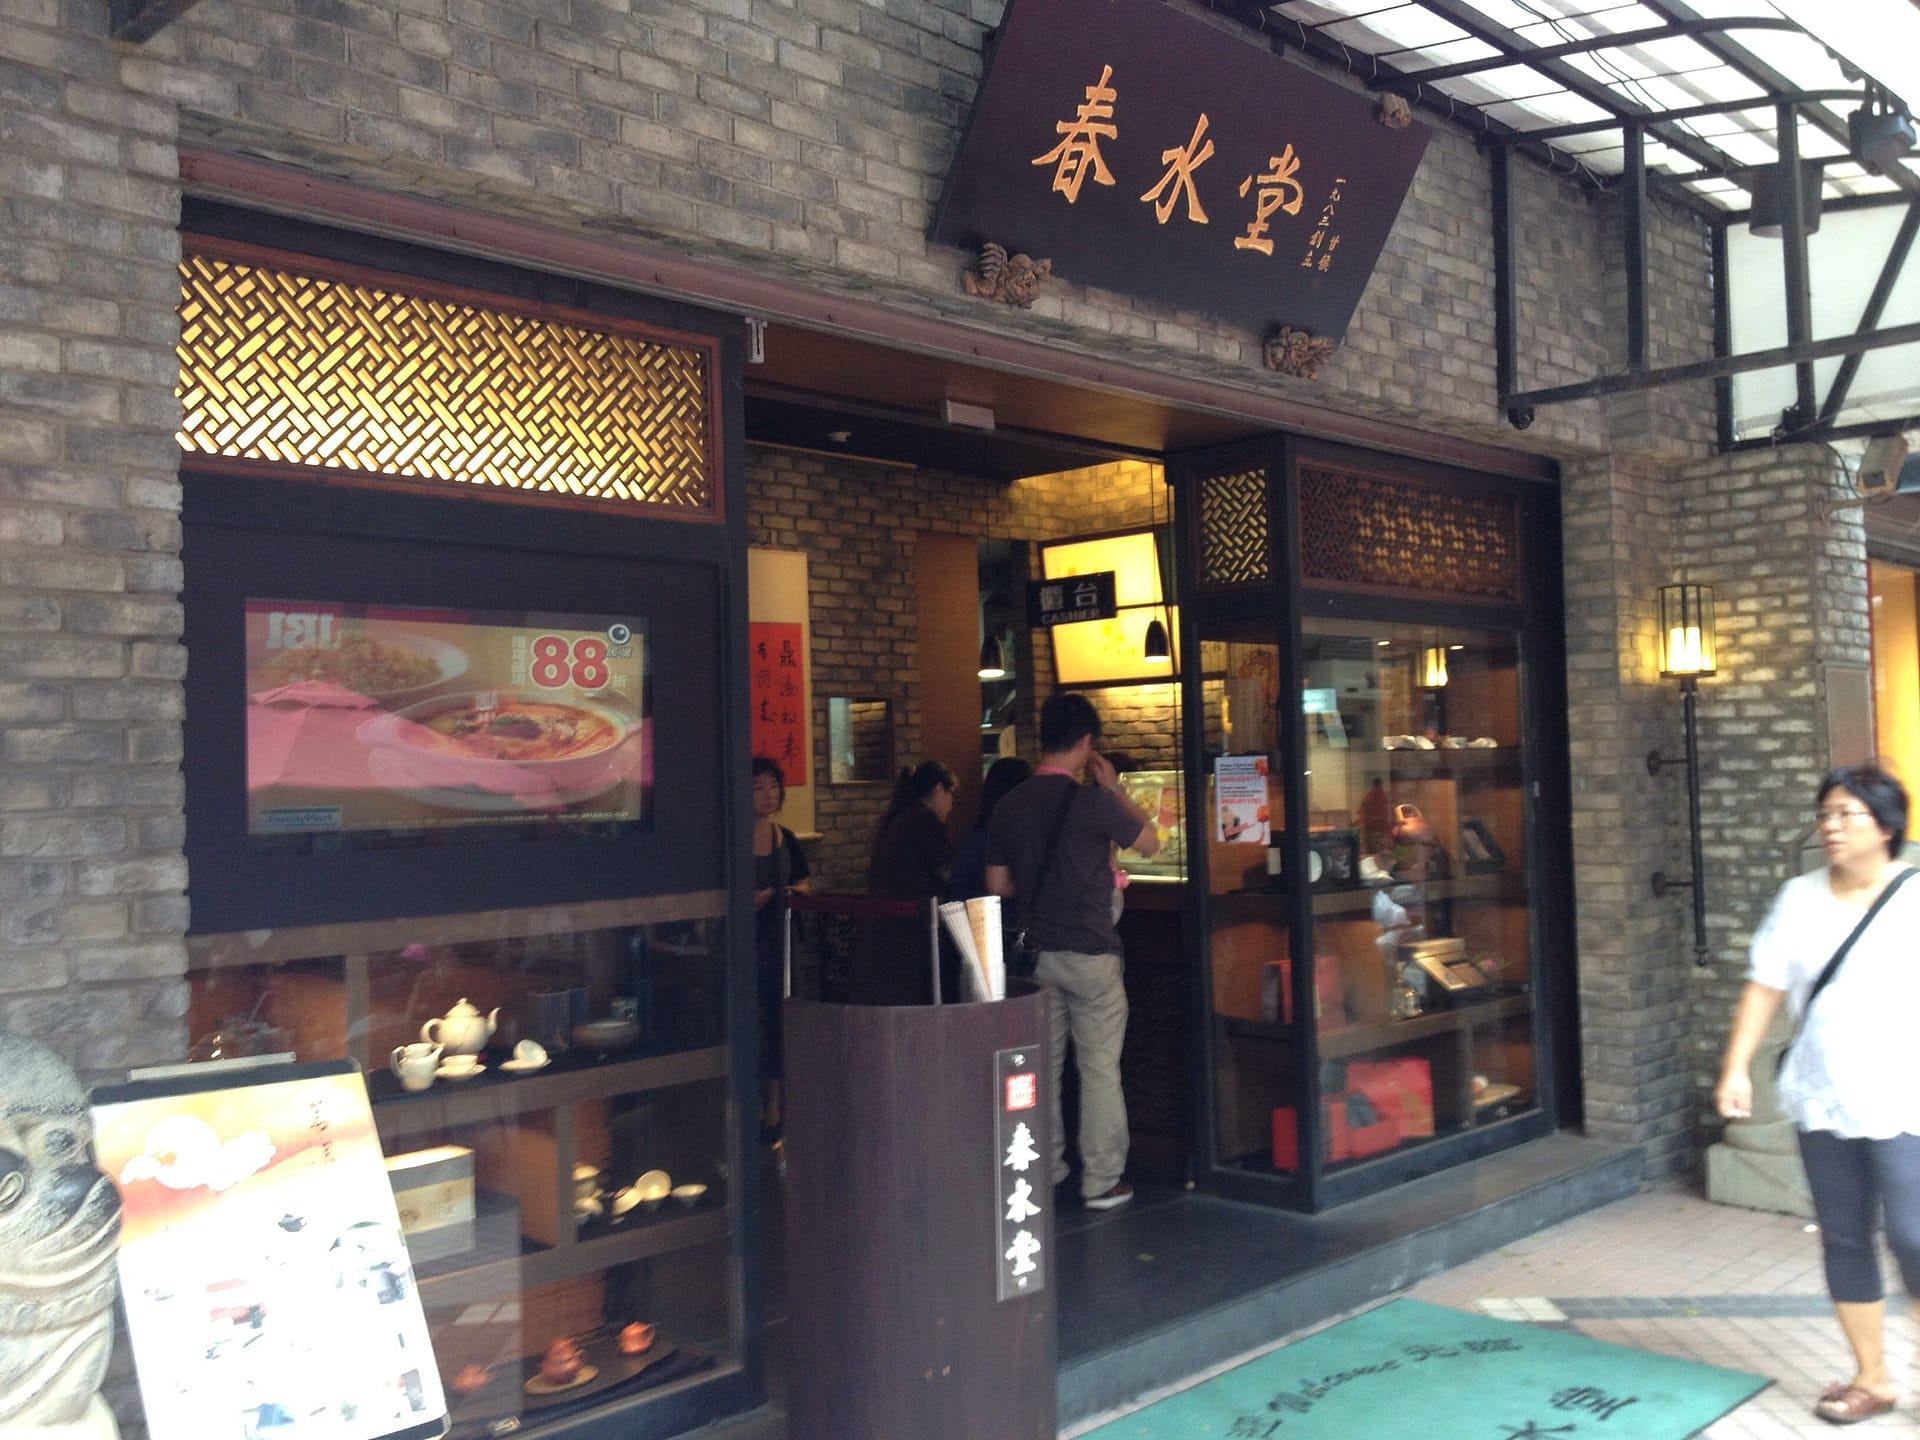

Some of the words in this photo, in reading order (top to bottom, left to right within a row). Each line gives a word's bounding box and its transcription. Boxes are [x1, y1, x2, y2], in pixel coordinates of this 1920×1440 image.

[1032, 64, 1304, 256] 春水堂
[531, 635, 611, 690] 88
[1041, 608, 1102, 626] CASHIER
[1003, 1121, 1042, 1277] 春水堂
